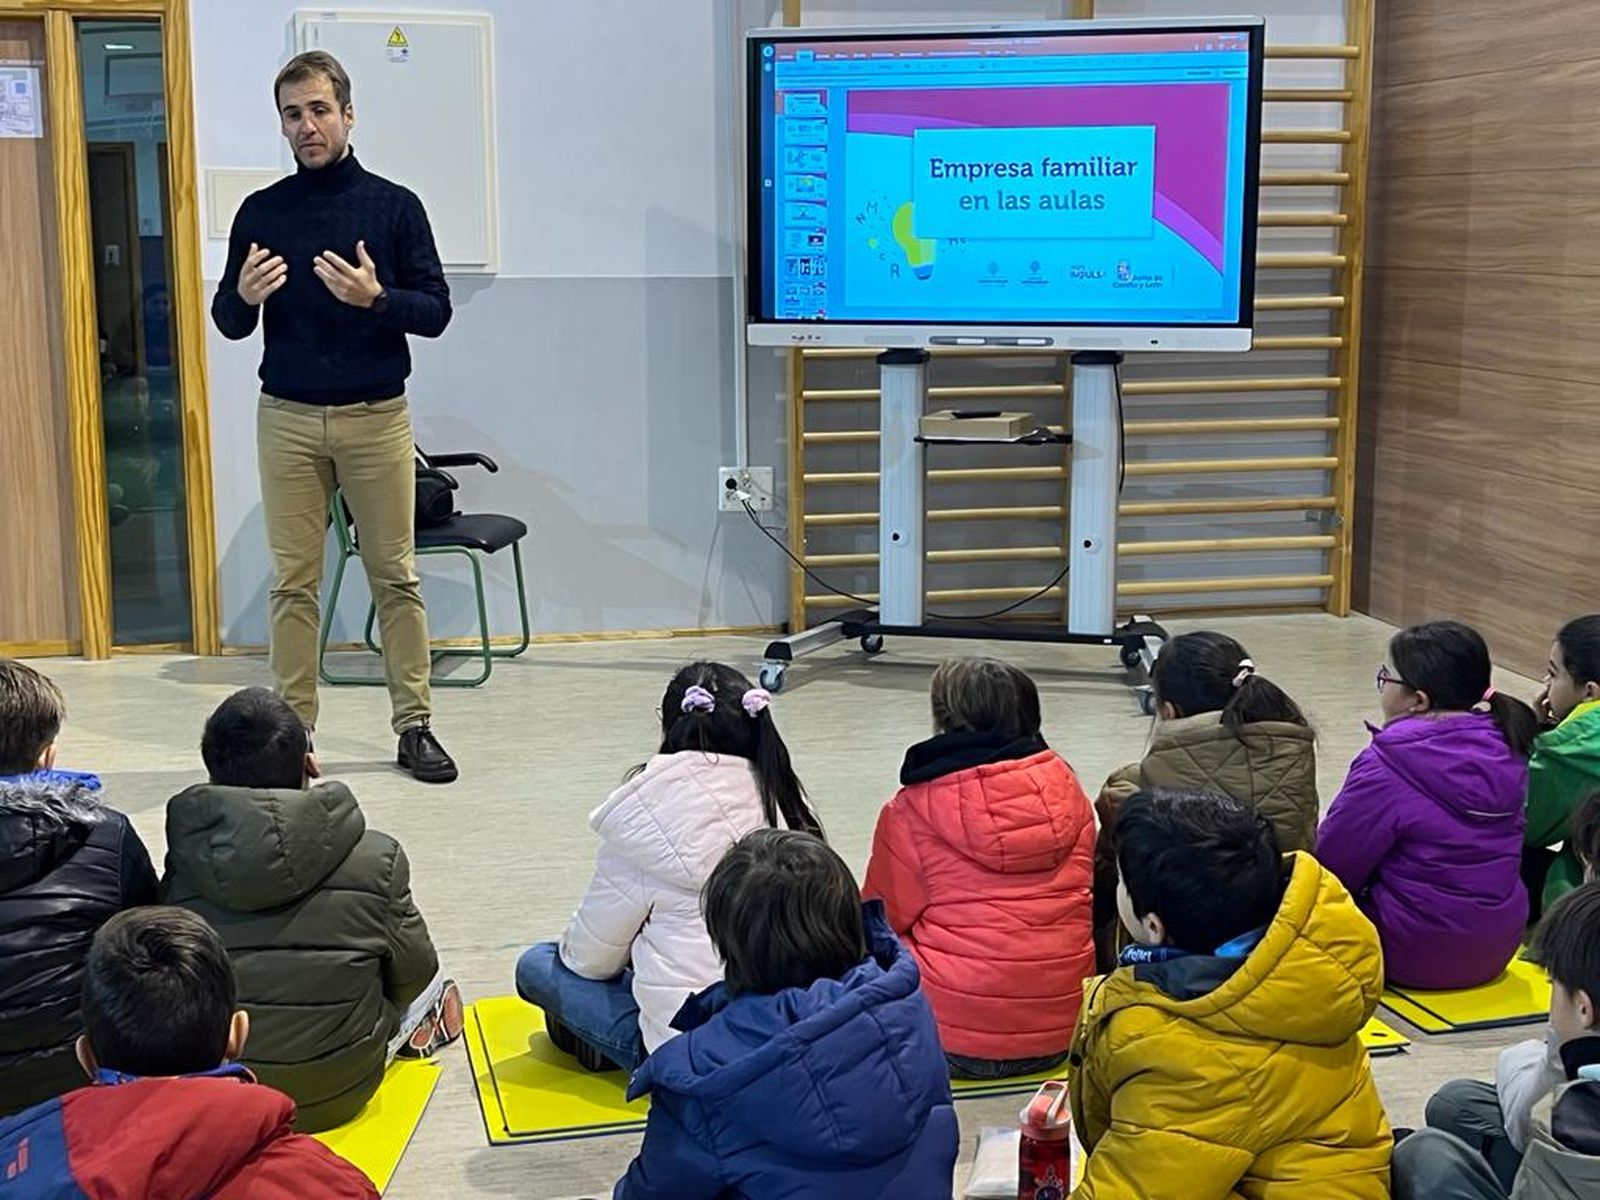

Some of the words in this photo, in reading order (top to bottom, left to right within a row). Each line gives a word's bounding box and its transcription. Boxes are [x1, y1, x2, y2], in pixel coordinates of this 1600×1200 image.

[930, 158, 1034, 183] Empresa
[1041, 156, 1138, 177] familiar
[959, 194, 989, 210] en
[997, 190, 1030, 210] las
[1039, 189, 1105, 210] aulas
